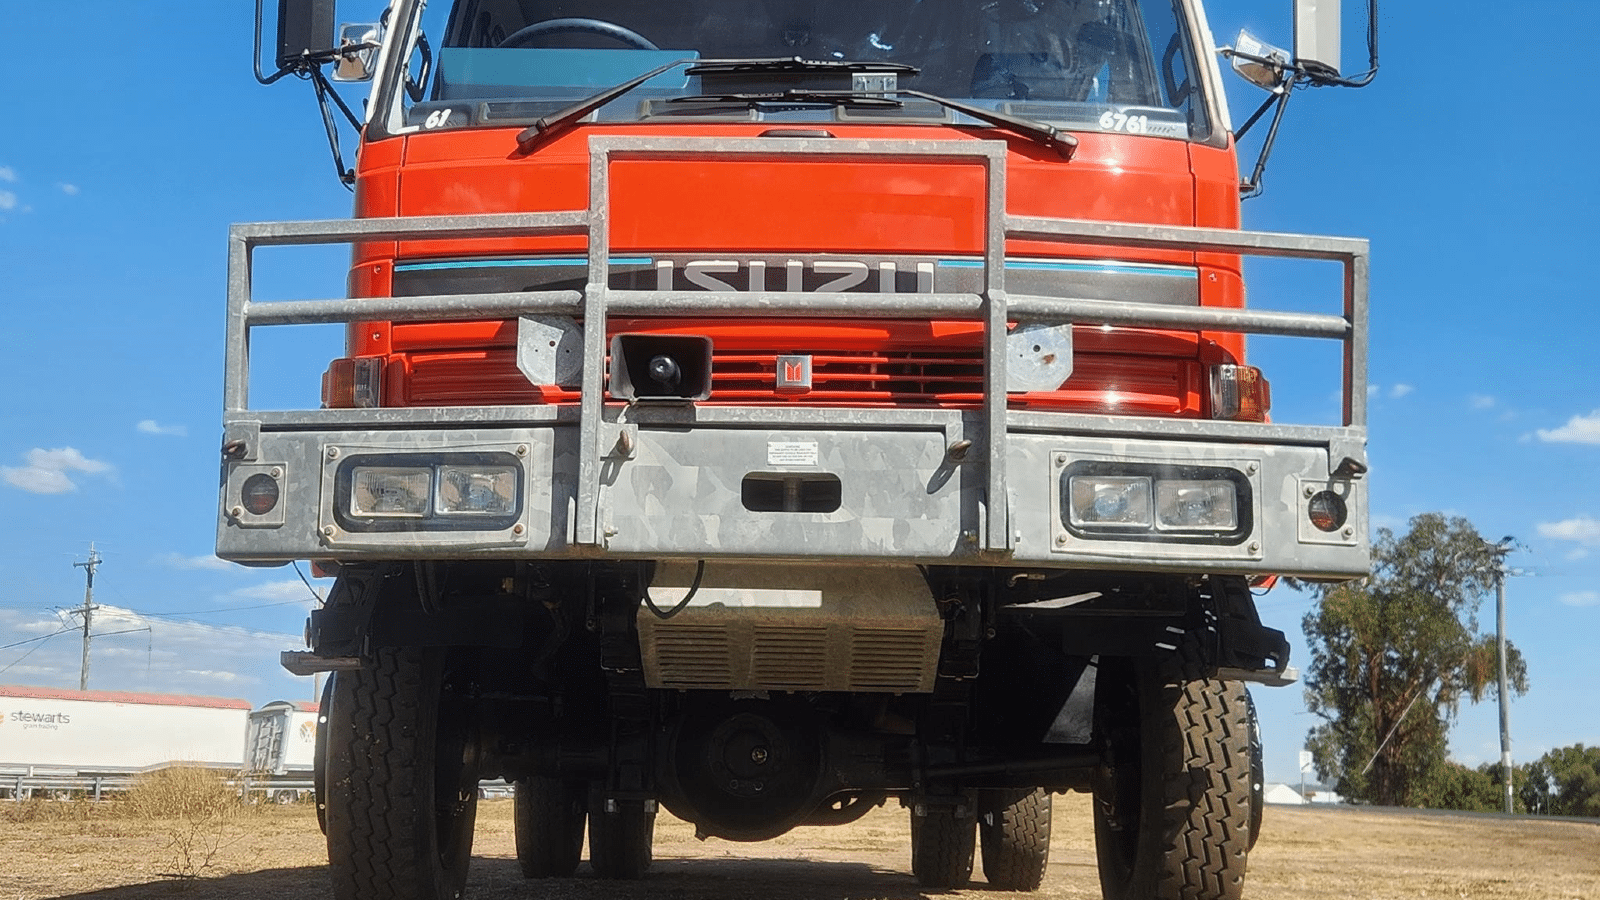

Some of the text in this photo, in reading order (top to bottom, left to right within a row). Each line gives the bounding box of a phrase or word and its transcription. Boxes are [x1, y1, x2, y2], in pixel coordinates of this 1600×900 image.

[425, 108, 452, 129] 61
[1099, 111, 1148, 134] 6761
[11, 710, 70, 724] stewarts
